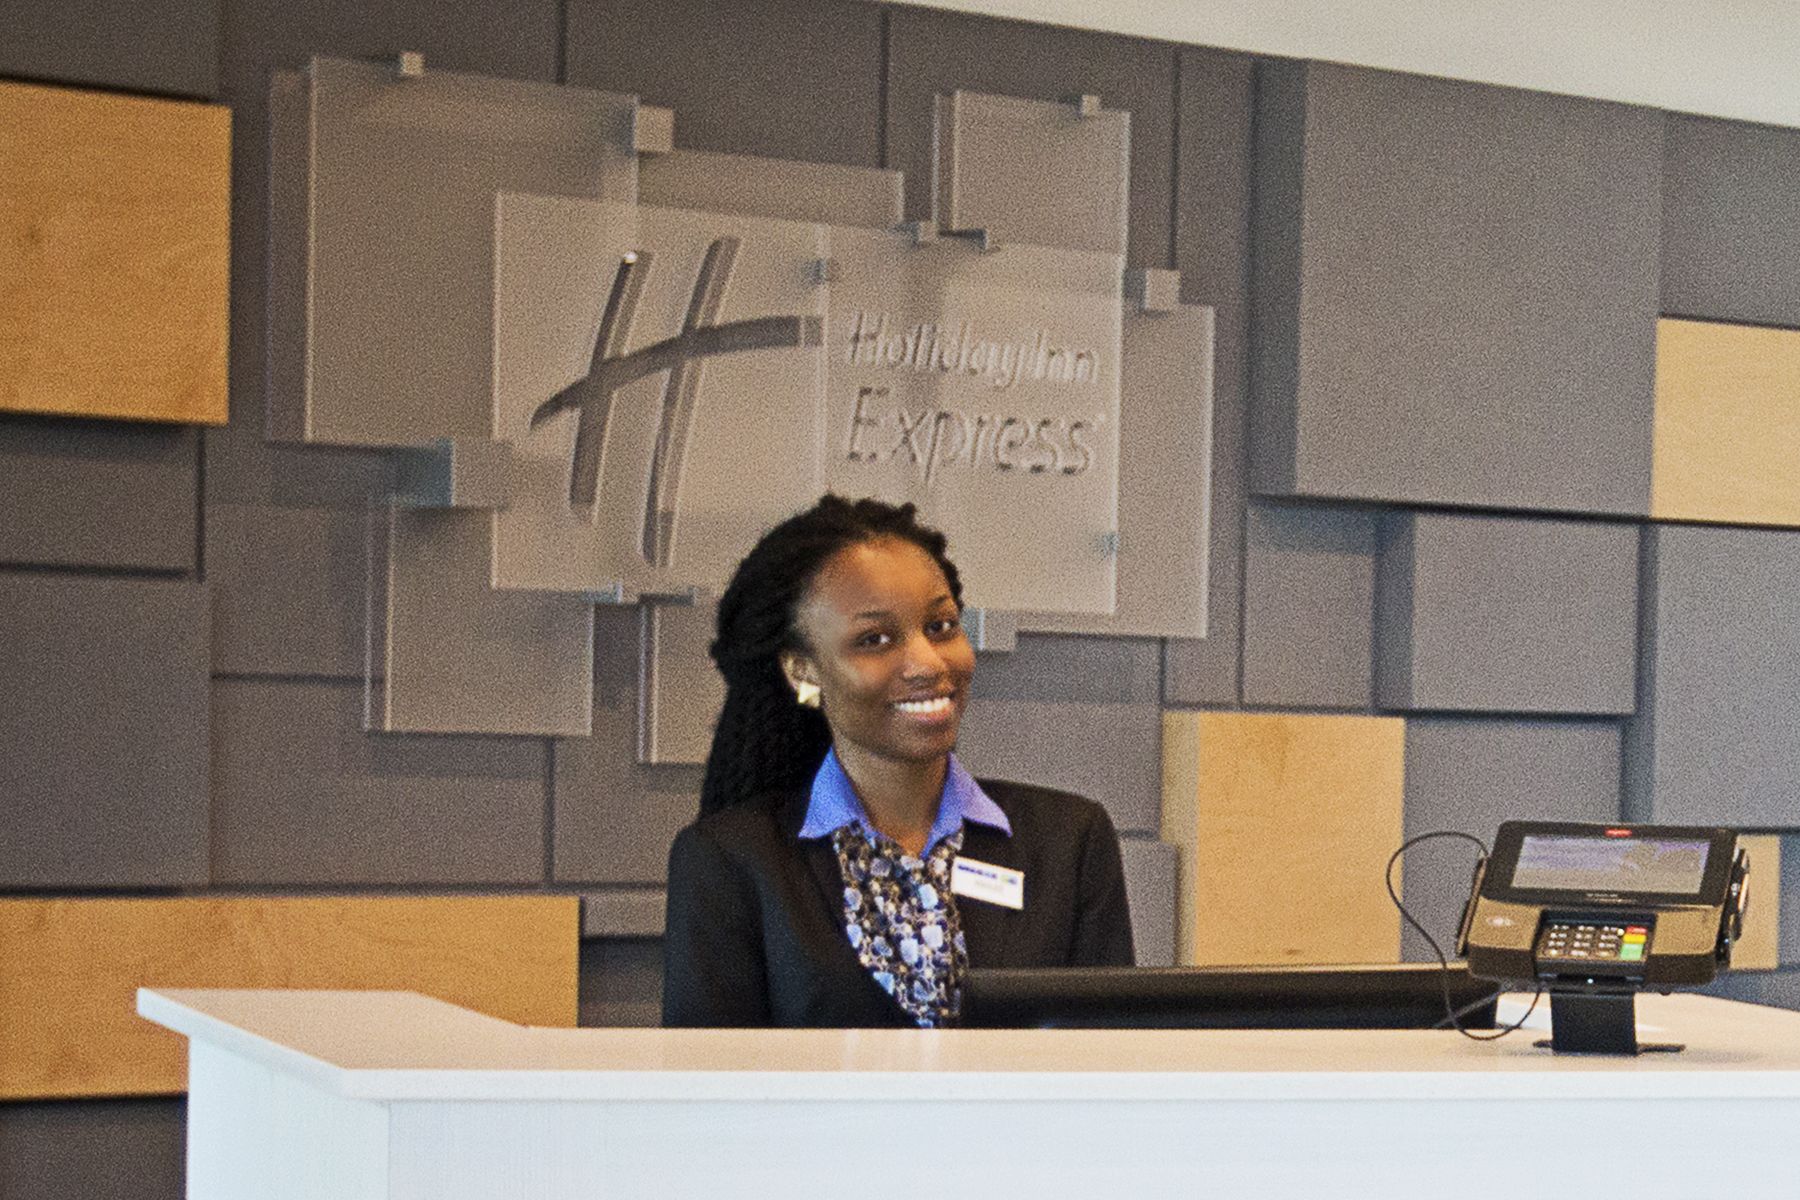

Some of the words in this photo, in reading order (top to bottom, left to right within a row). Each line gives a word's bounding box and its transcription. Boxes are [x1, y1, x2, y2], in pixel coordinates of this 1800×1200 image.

[850, 311, 1026, 390] Holiday
[1033, 328, 1100, 384] Inn
[848, 386, 1092, 486] Express
